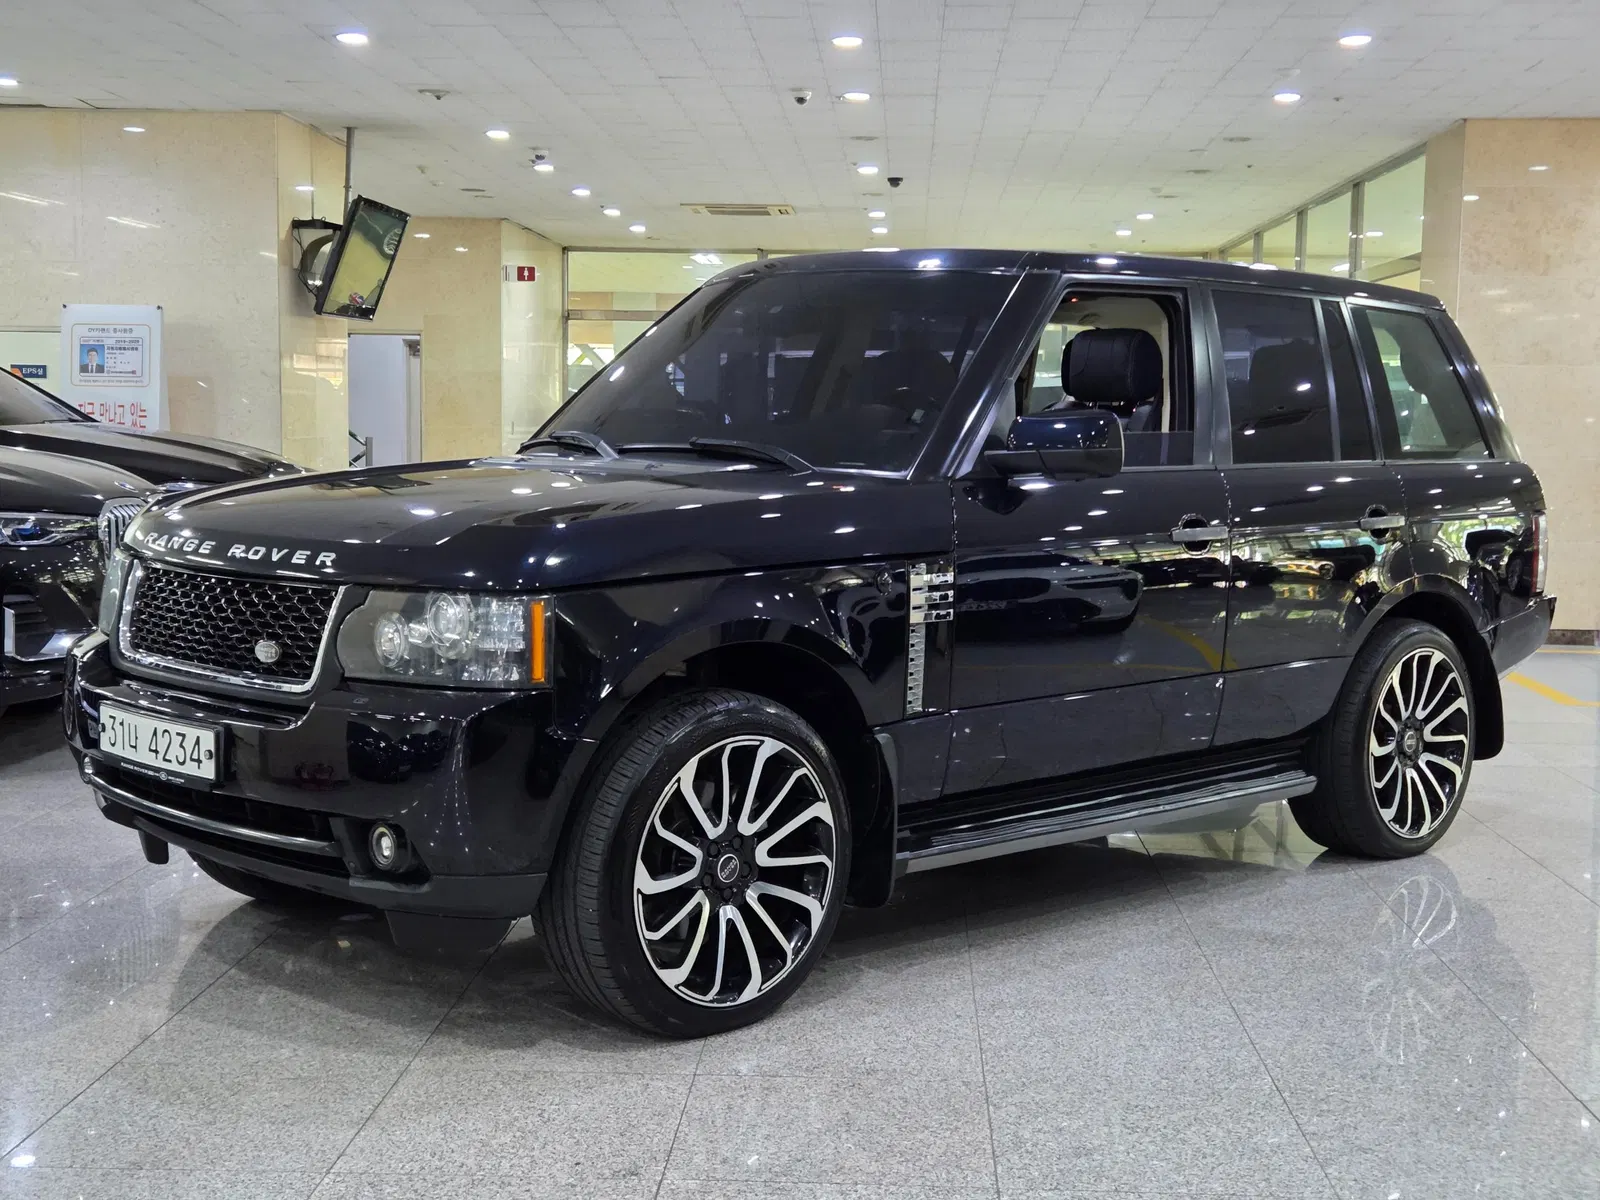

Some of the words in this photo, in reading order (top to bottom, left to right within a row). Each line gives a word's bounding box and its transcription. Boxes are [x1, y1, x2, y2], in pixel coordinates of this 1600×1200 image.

[130, 401, 147, 428] 있는
[144, 532, 216, 554] RANGE
[227, 543, 337, 566] ROVER
[108, 714, 138, 753] 31나
[148, 726, 203, 770] 4234
